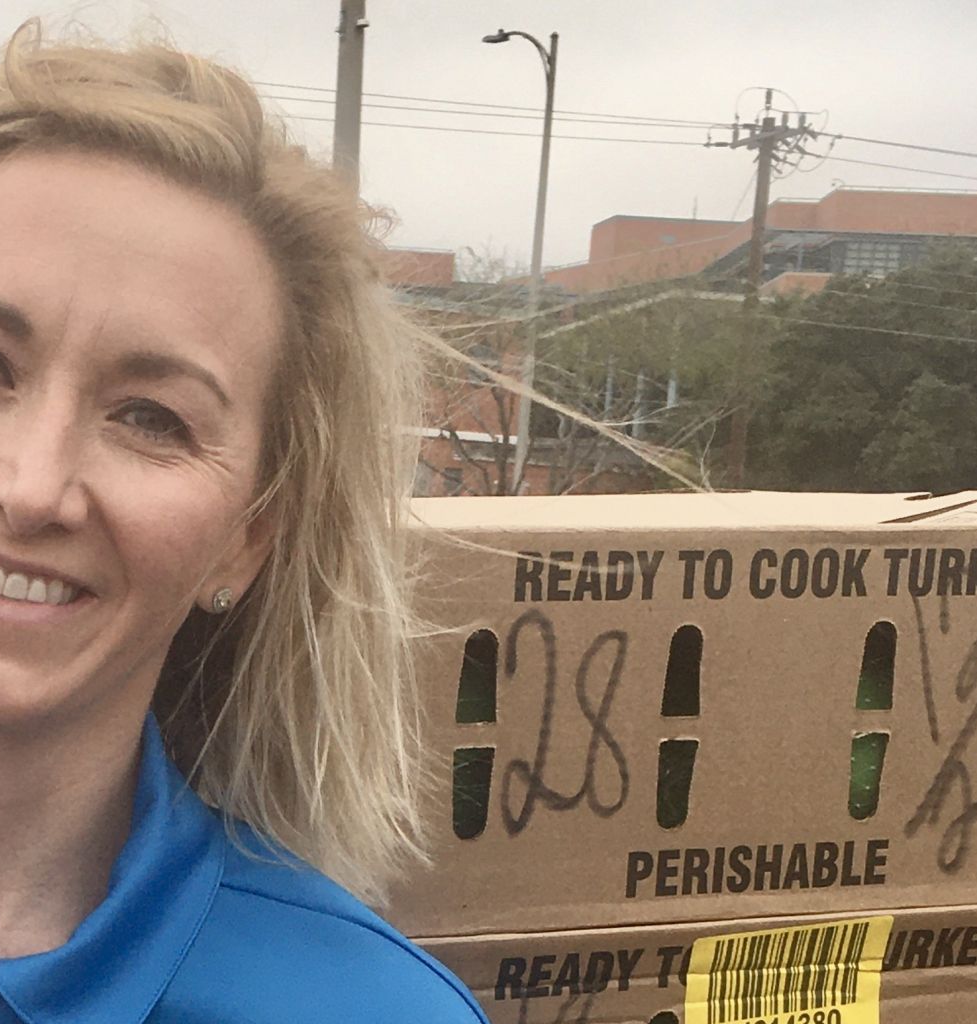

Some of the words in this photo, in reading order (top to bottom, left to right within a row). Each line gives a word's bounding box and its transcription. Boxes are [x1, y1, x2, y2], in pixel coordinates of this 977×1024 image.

[514, 549, 665, 602] READY
[679, 549, 733, 600] TO
[748, 548, 871, 598] COOK
[500, 607, 630, 839] 28
[625, 838, 889, 898] PERISHABLE
[494, 947, 647, 1000] READY
